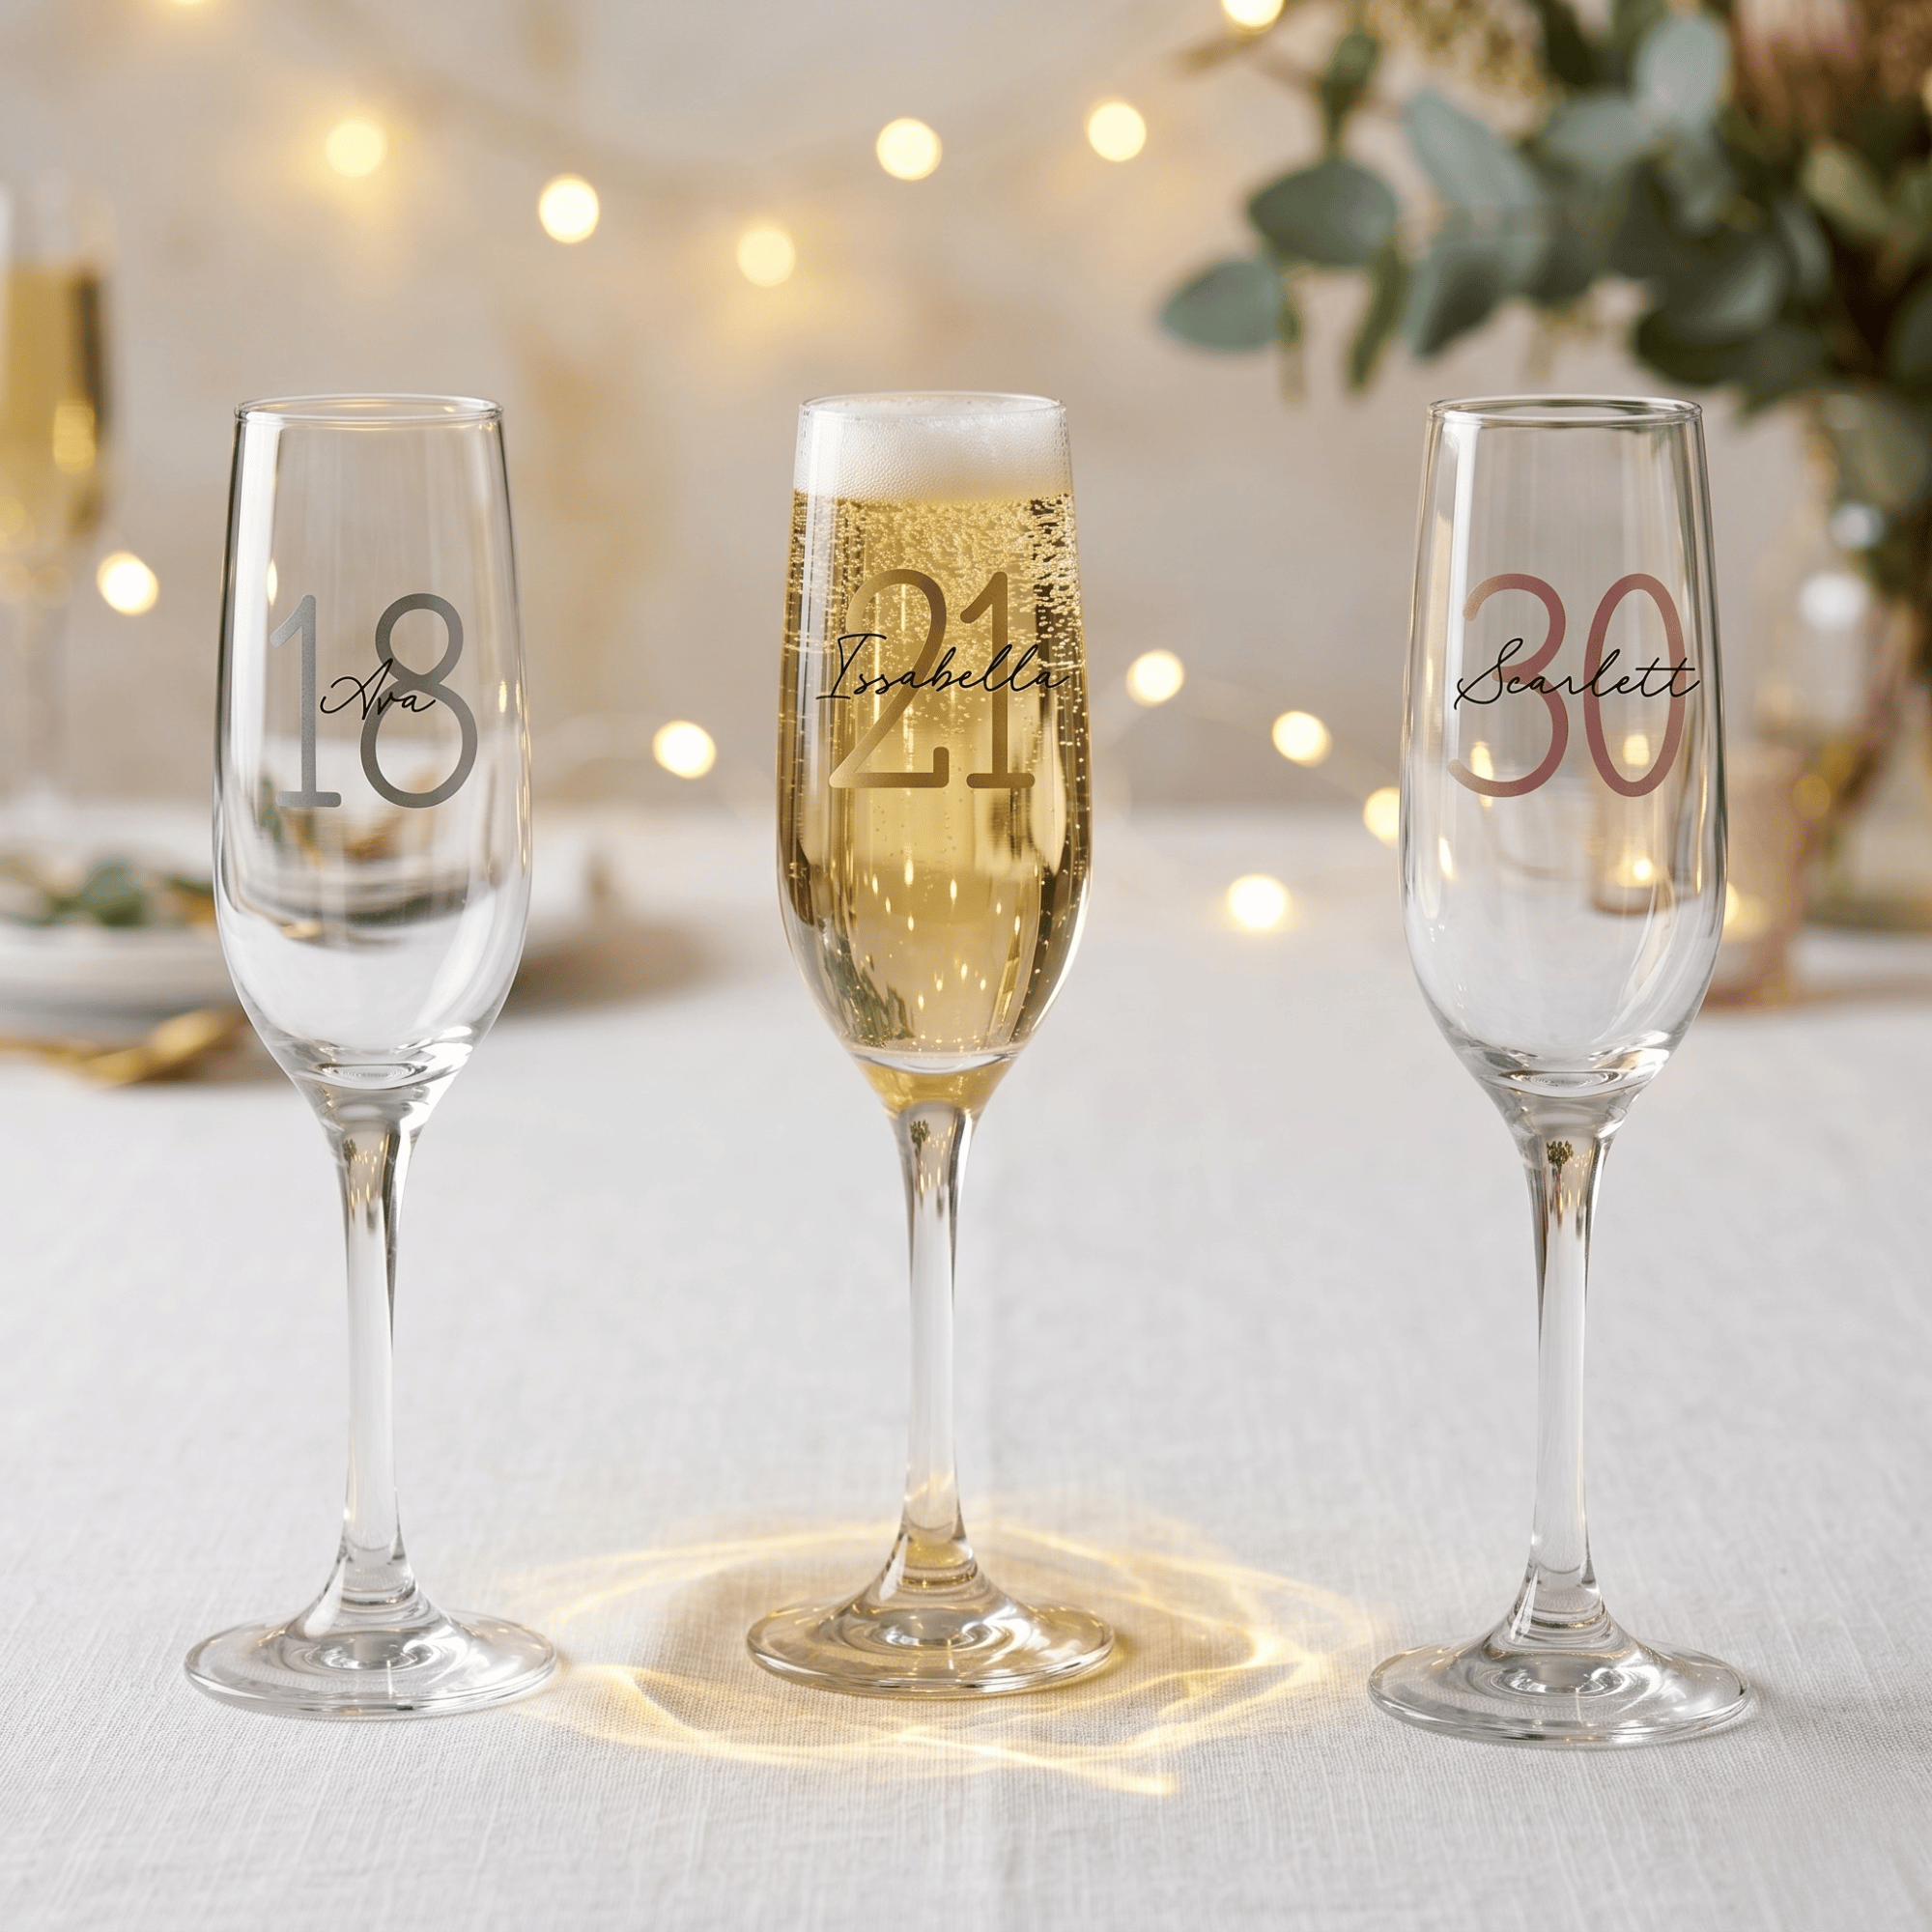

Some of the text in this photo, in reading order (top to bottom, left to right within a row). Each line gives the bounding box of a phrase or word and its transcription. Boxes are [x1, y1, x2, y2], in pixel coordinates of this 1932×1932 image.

[270, 592, 478, 809] 18
[320, 658, 437, 720] Ava
[815, 633, 1070, 700] Issabella
[829, 568, 1036, 789] 21
[1447, 573, 1687, 798] 30
[1454, 638, 1701, 710] Scarlett
